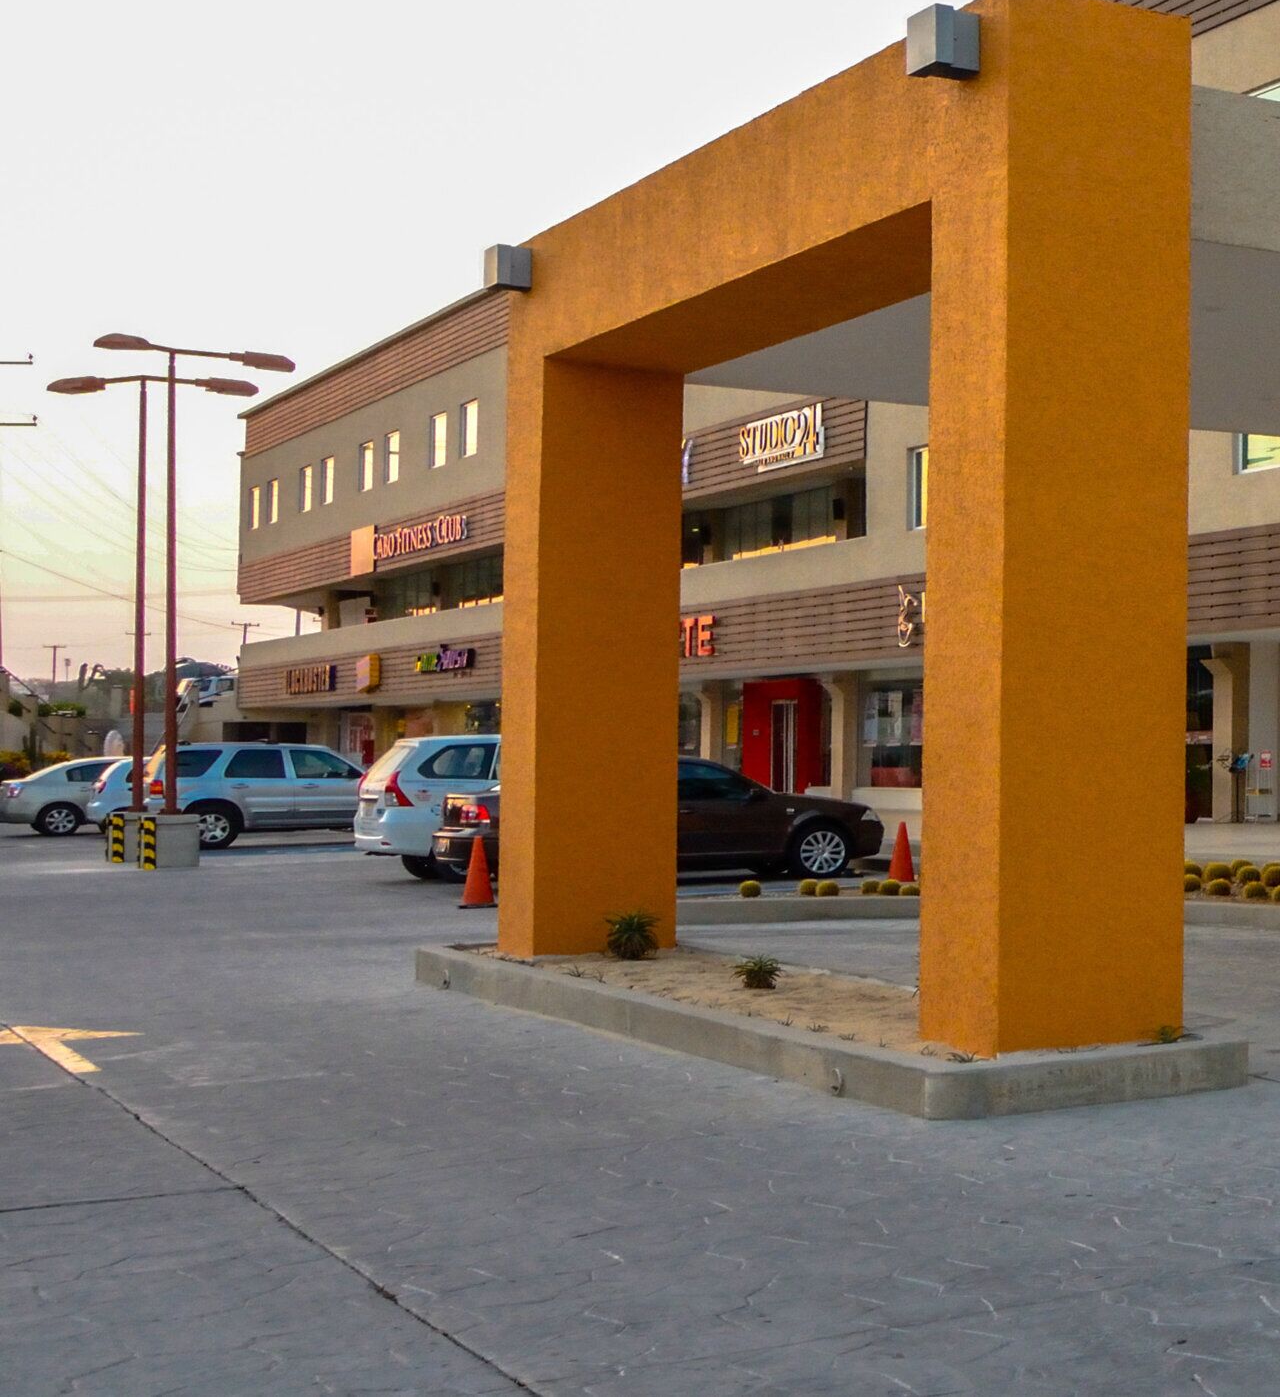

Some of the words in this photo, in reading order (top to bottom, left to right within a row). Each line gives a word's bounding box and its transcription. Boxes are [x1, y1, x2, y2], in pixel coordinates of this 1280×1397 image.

[739, 415, 797, 459] STUDIO
[373, 534, 395, 559] CABO
[395, 522, 435, 555] FITNESS
[436, 515, 467, 544] CLUB
